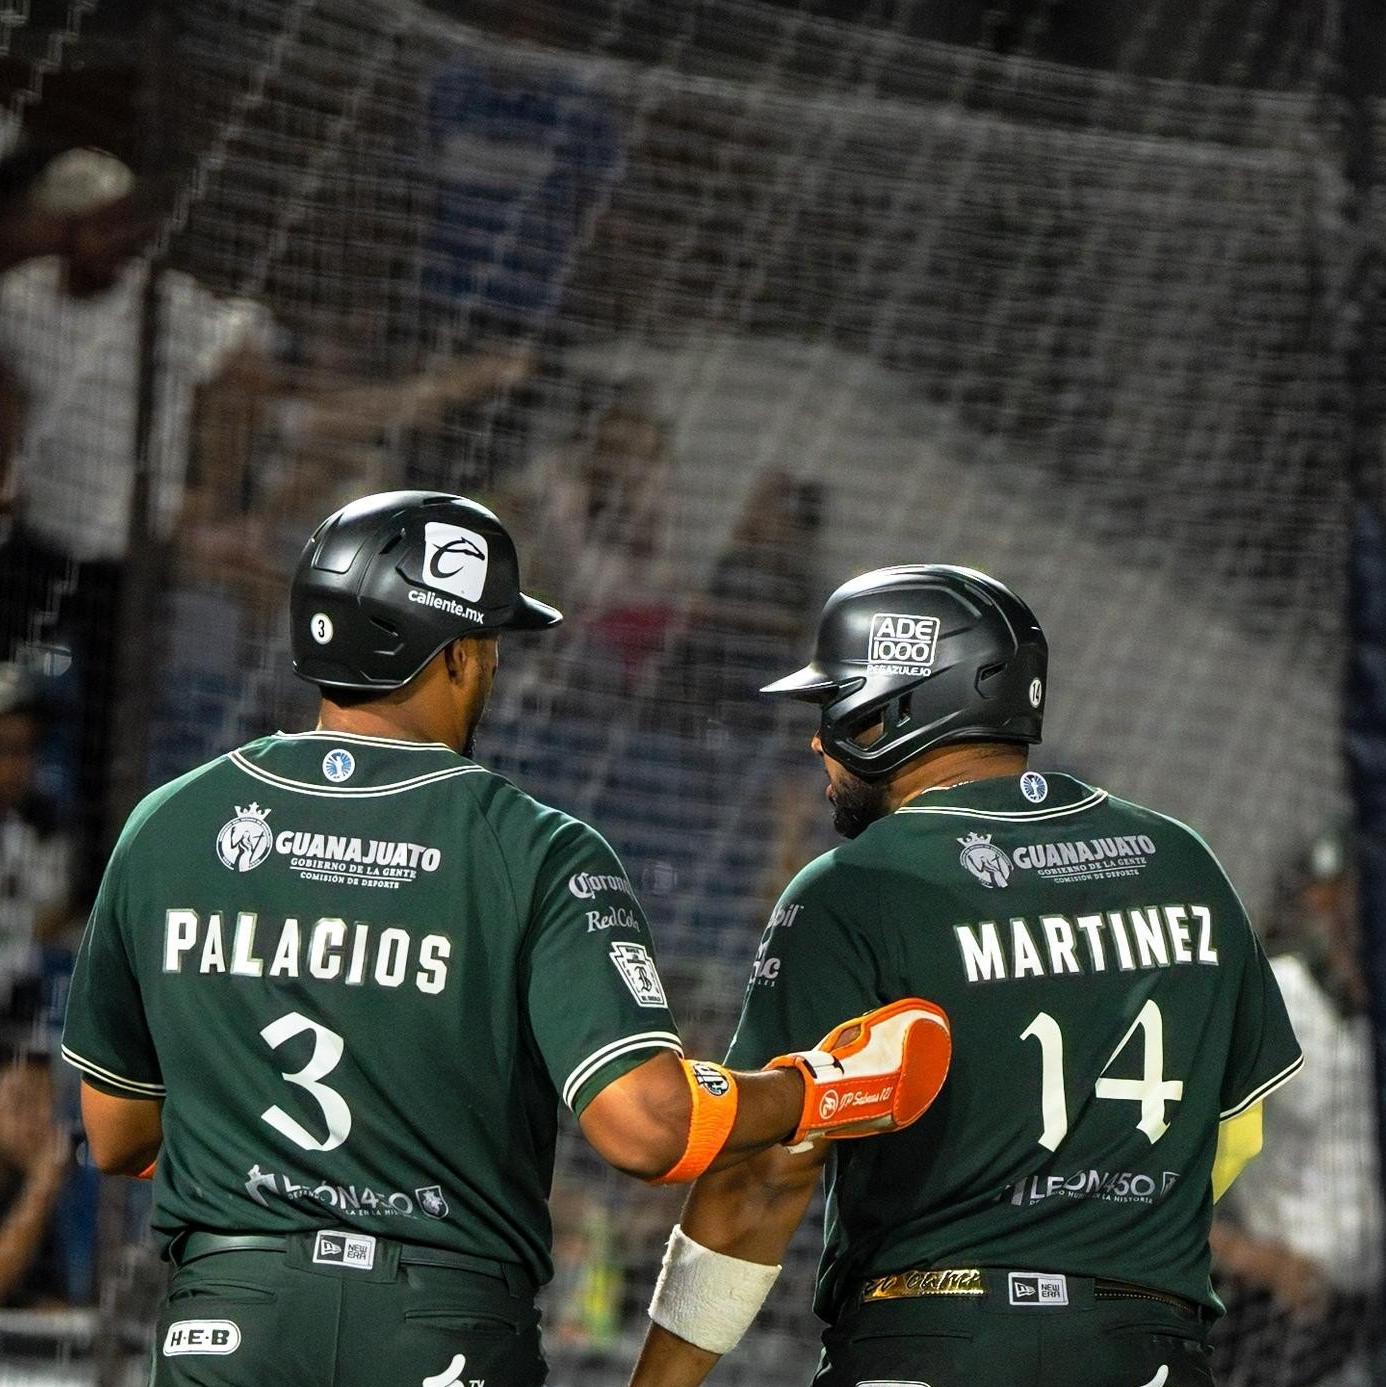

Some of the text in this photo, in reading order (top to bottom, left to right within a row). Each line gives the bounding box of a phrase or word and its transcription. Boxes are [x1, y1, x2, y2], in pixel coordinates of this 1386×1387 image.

[408, 590, 484, 624] caliente.mx
[318, 619, 325, 638] 3
[876, 617, 933, 640] ADE
[873, 641, 929, 661] 1000
[275, 831, 441, 872] GUANAJUATO
[1013, 835, 1156, 869] GUANAJUATO
[290, 858, 416, 878] GOBIERNO DE LA GENTE
[1038, 857, 1147, 876] GOBIERNO DE LA GENTE
[1095, 872, 1105, 880] DE
[361, 879, 399, 888] DEPORTE
[163, 908, 451, 994] PALACIOS
[954, 904, 1219, 983] MARTINEZ
[259, 1011, 351, 1151] 3
[1019, 999, 1184, 1152] 14
[347, 1244, 367, 1253] NEW
[347, 1251, 366, 1260] ERA
